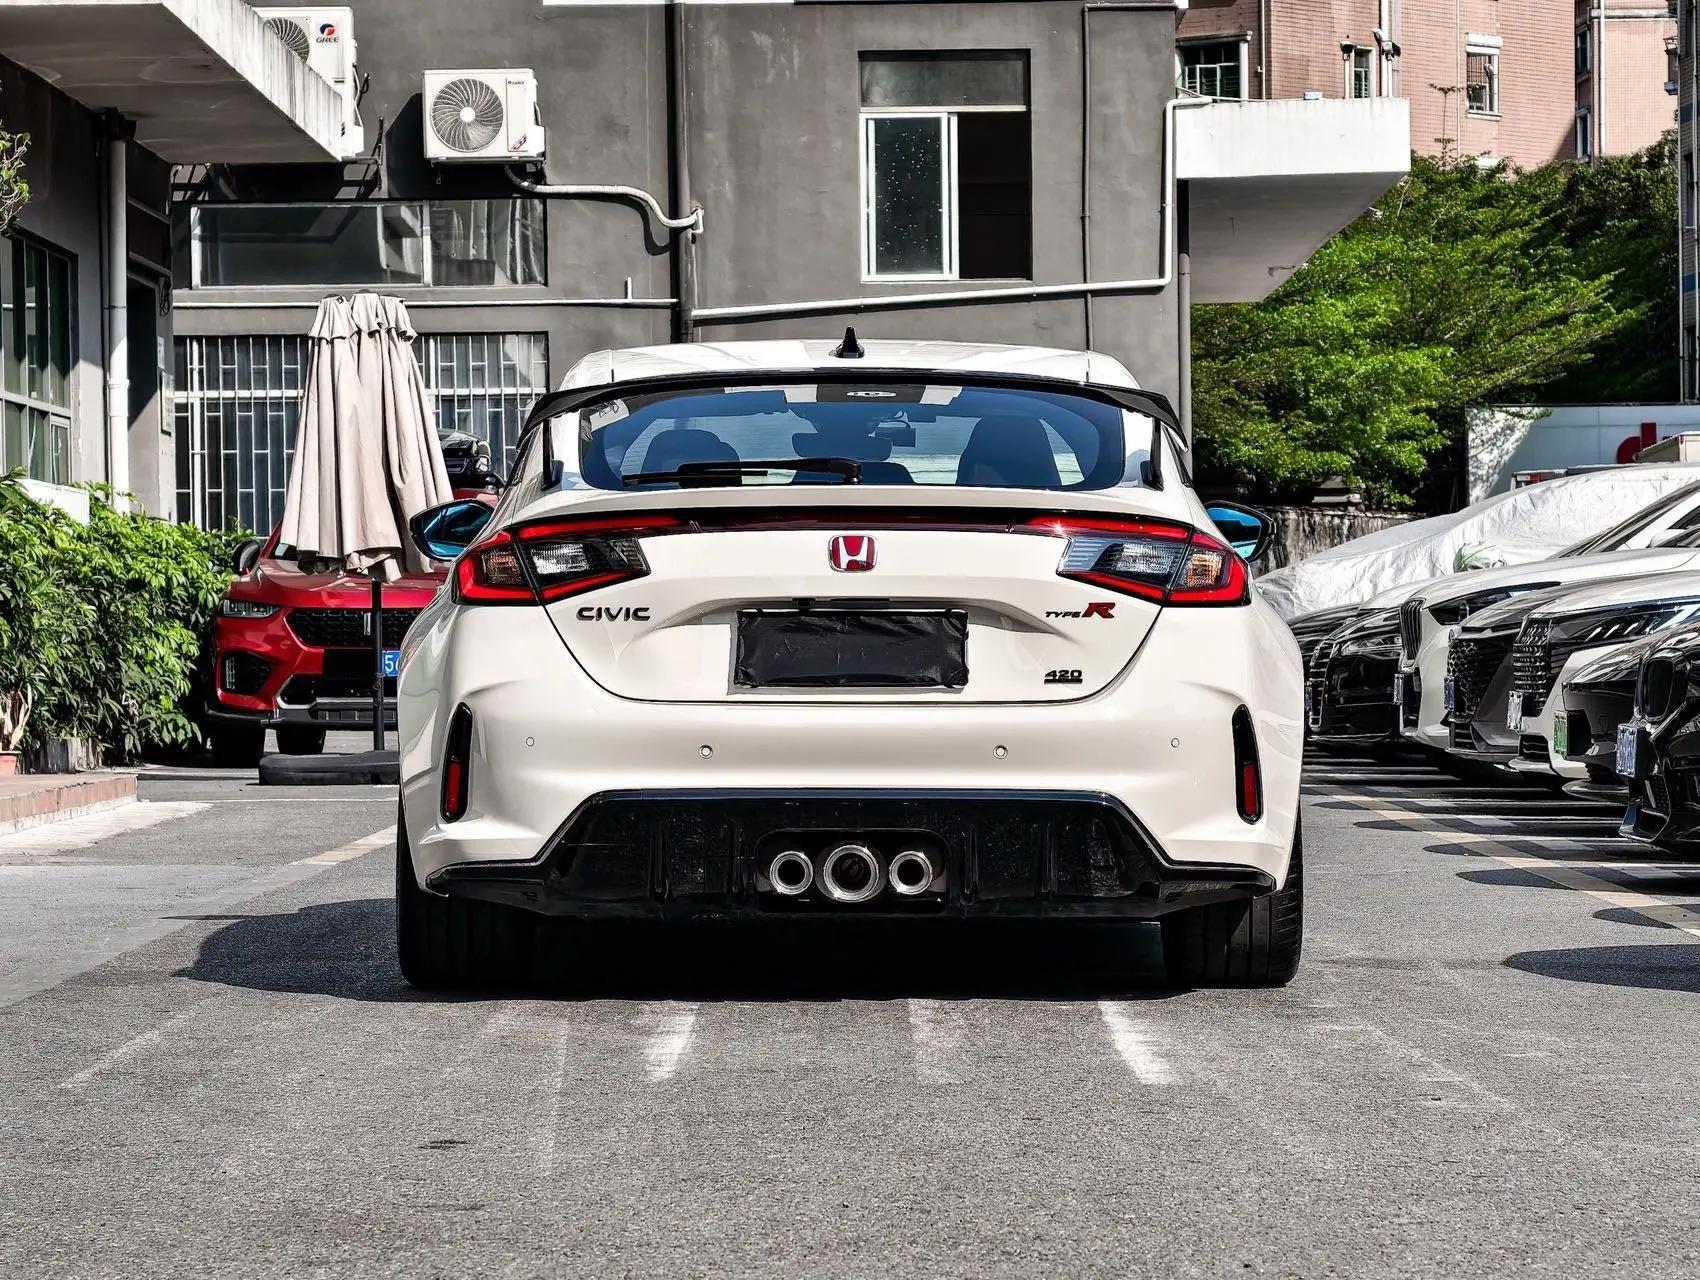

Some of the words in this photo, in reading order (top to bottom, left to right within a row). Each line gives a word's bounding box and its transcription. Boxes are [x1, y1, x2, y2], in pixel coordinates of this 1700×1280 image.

[576, 606, 651, 621] CIVIC
[1081, 602, 1116, 619] R
[1044, 669, 1083, 680] 420
